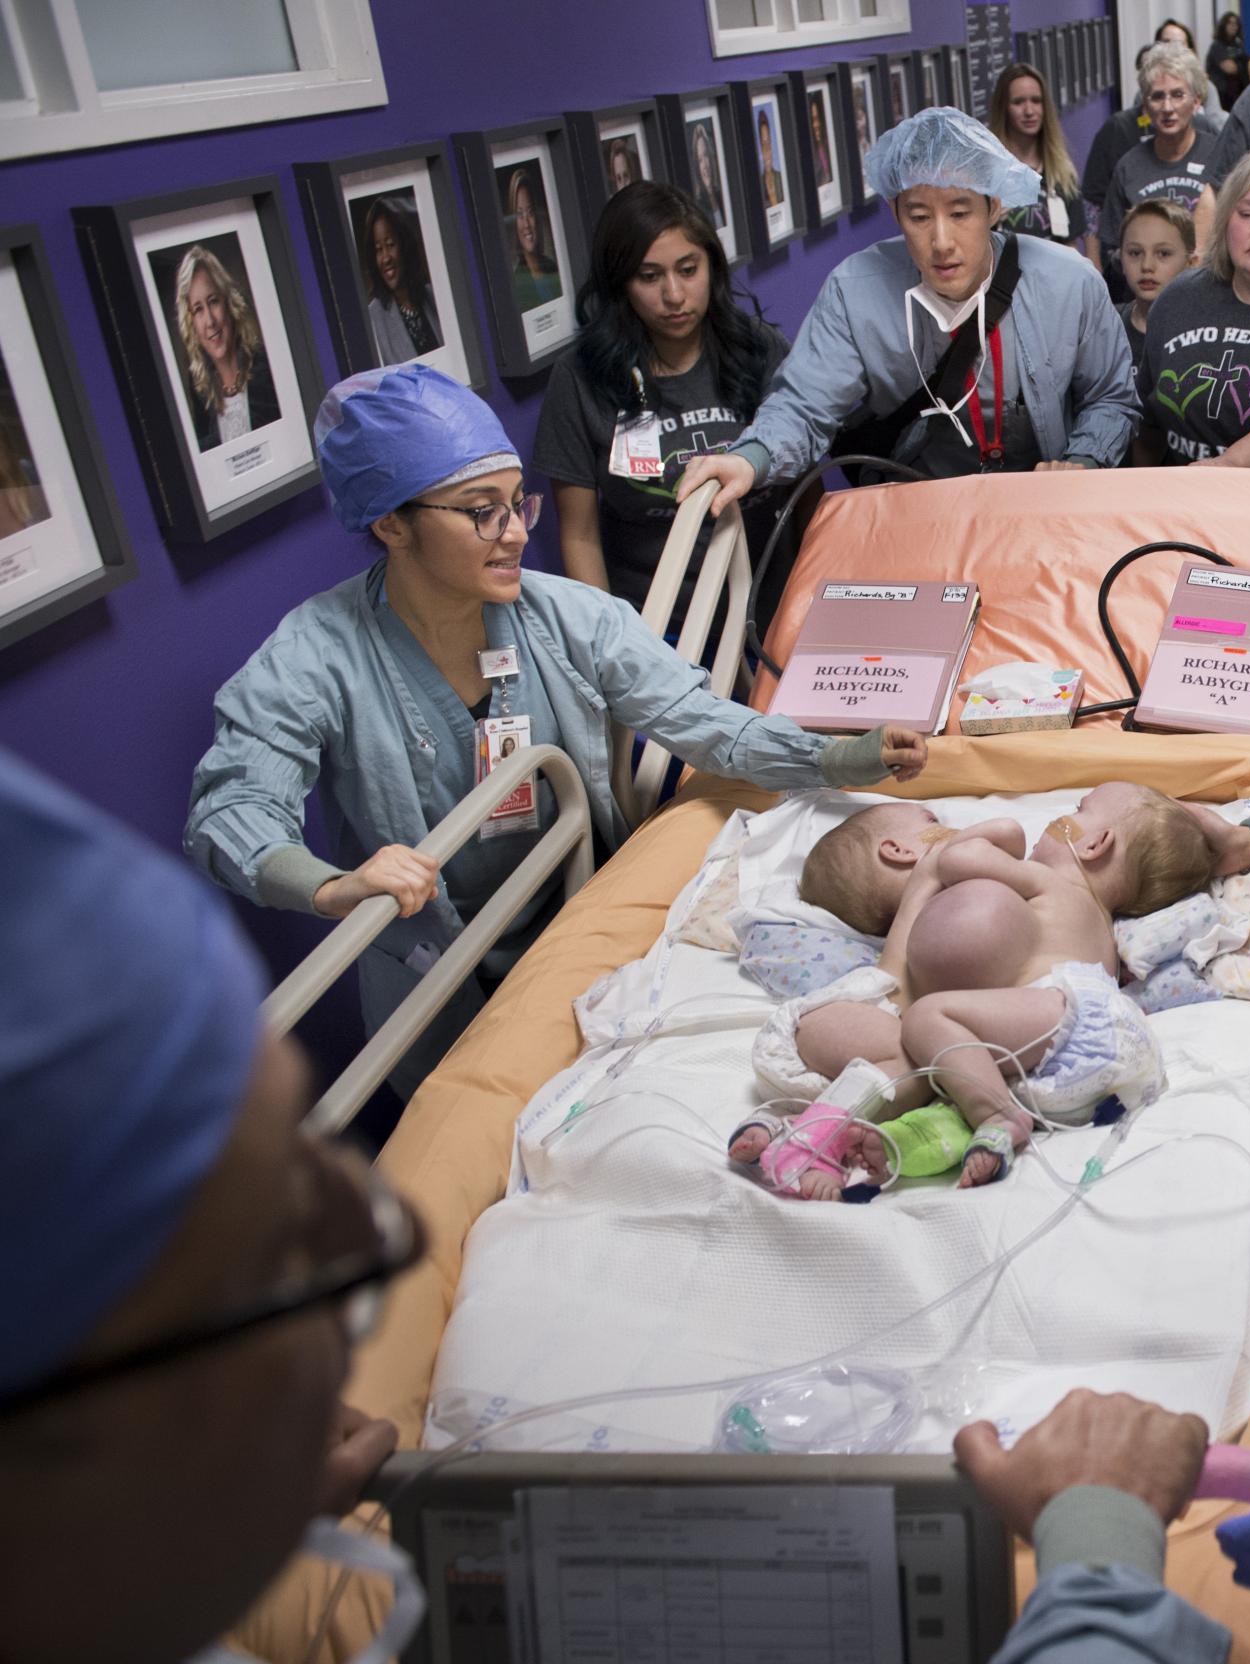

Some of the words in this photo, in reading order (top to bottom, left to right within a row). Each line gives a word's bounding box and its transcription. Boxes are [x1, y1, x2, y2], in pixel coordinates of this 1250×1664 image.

[1139, 179, 1165, 197] TWO
[1165, 176, 1205, 193] HEARTS
[1164, 326, 1219, 355] TWO
[1167, 429, 1211, 460] ONE
[634, 461, 657, 474] RN
[815, 666, 909, 679] RICHARDS,
[812, 681, 904, 693] BABYGIRL
